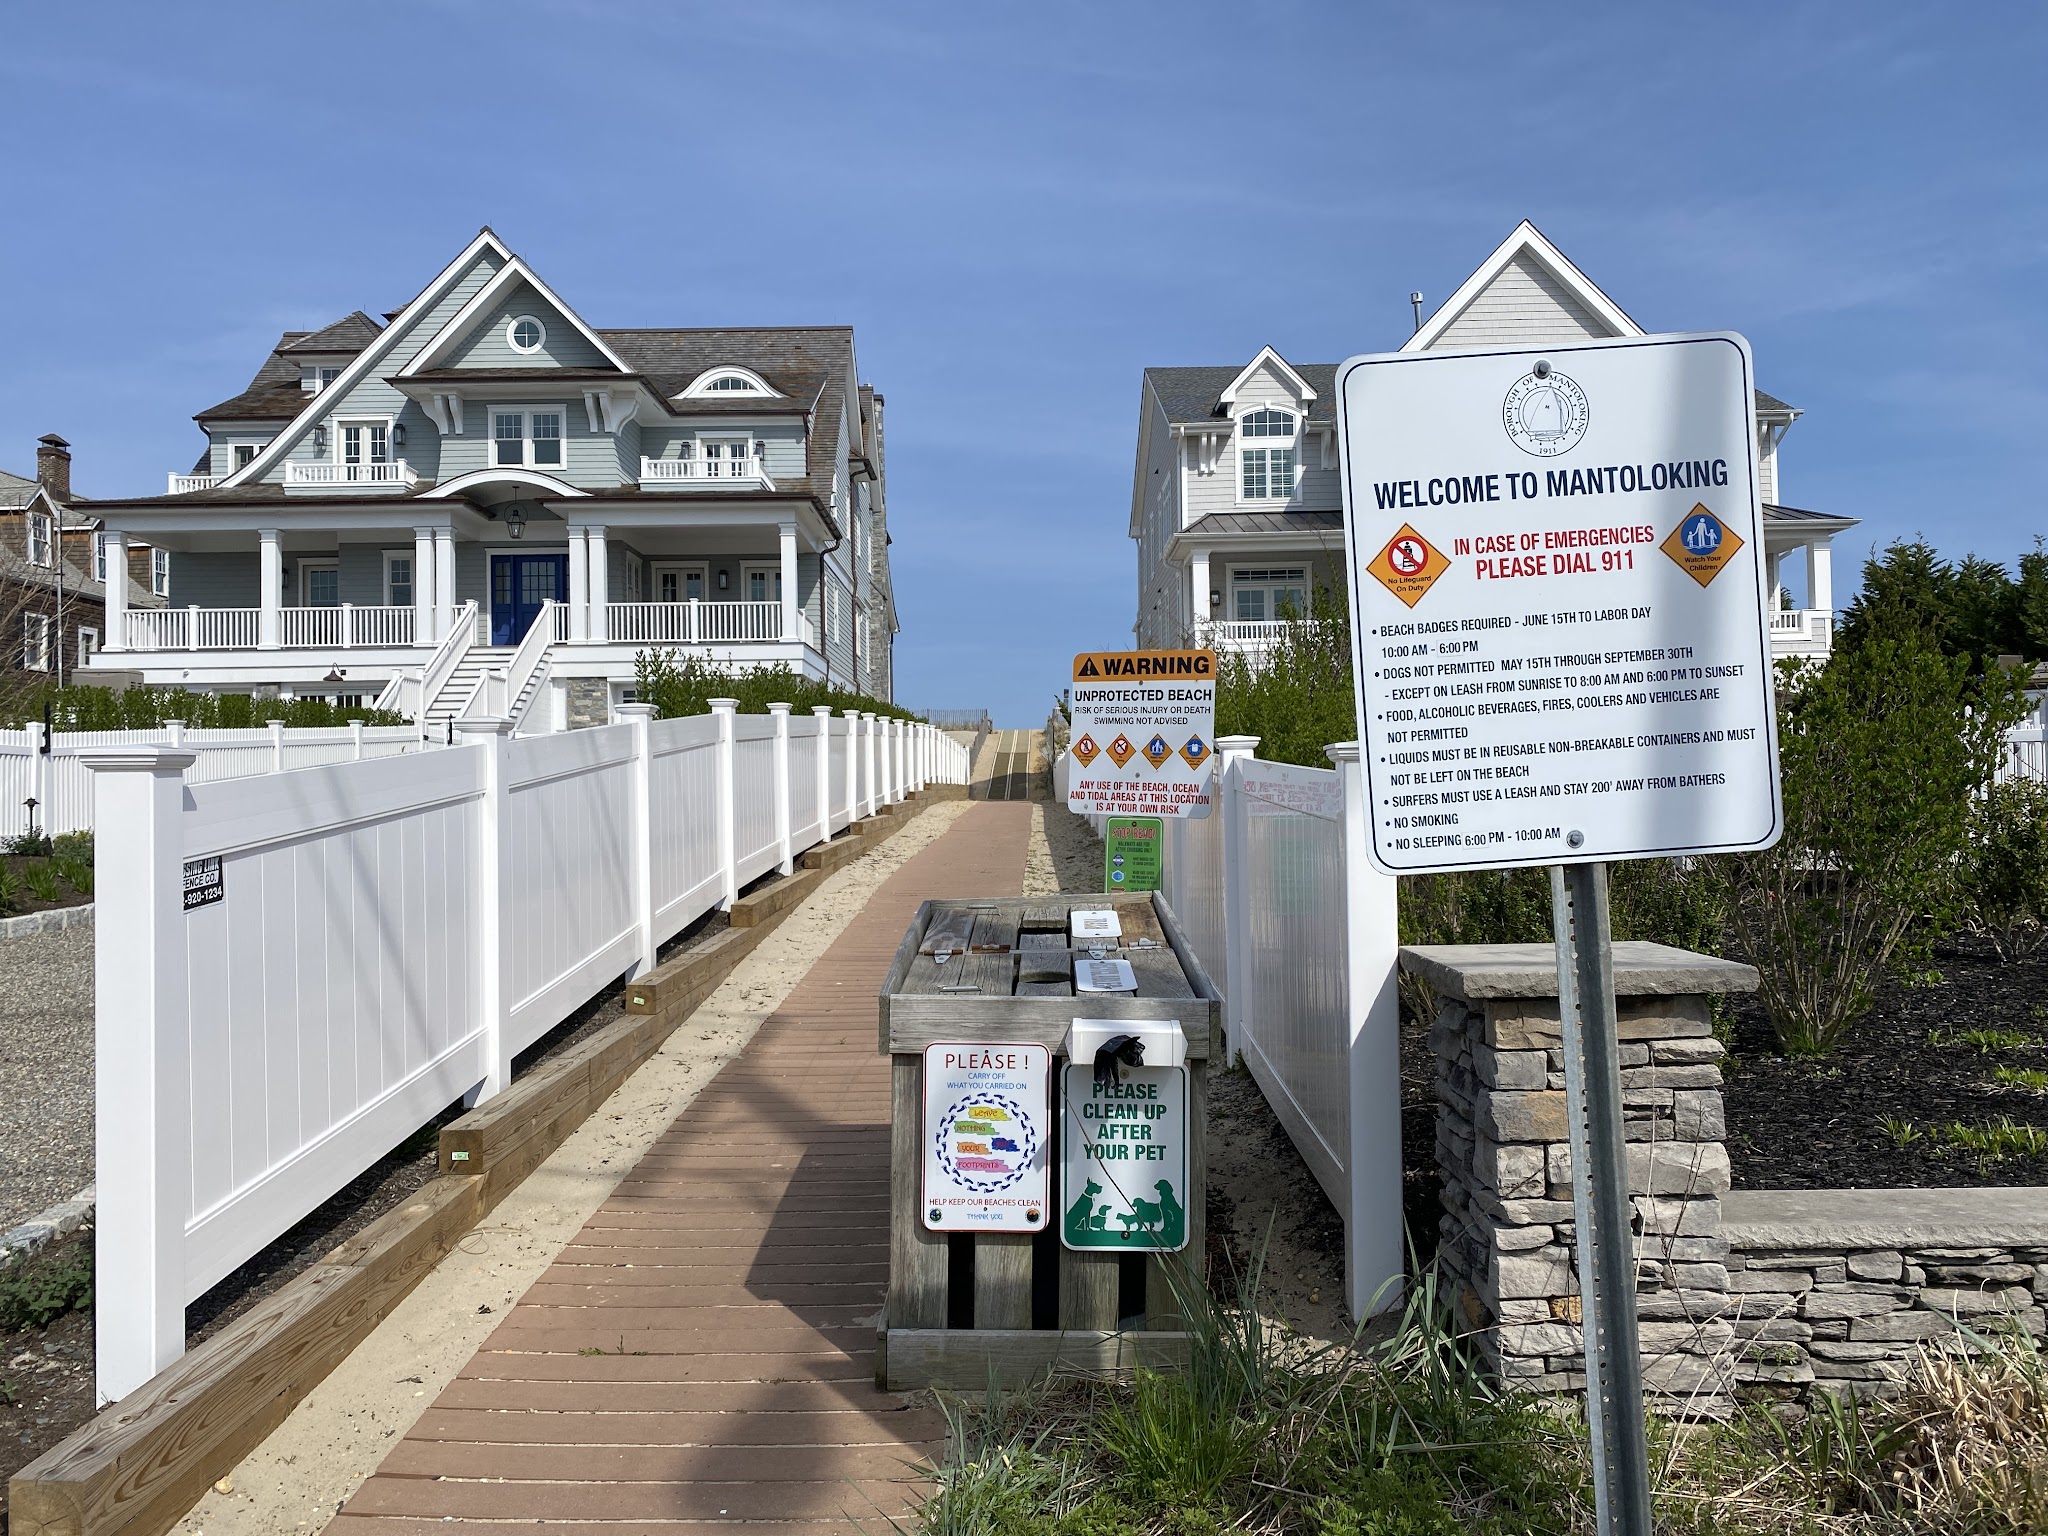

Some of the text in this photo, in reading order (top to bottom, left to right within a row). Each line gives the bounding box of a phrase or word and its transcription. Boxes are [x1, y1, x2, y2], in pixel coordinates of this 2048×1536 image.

[1506, 375, 1586, 436] BOROUGH OF MANTOLOKING
[1374, 459, 1728, 509] WELCOME TO MANTOLOKING
[1455, 526, 1654, 555] IN CASE OF EMERGENCIES
[1476, 550, 1632, 580] PLEASE DIAL 911
[1381, 607, 1651, 636] BEACH BADGES REQUIRED JUNE 15TH TO LABOR DAY
[1382, 640, 1478, 658] 10:00 AM 6:00 PM
[1103, 656, 1209, 675] WARNING
[1384, 647, 1692, 679] DOGS NOT PERMITTED MAY 15TH THROUGH SEPTEMBER 30TH
[1392, 665, 1744, 700] EXCEPT ON LEASH FROM SUNRISE TO 8:00 AM AND 6:00 PM TO SUNSET
[1075, 689, 1211, 701] UNPROTECTED BEACH
[1386, 688, 1720, 722] FOOD, ALCOHOLIC BEVERAGES, FIRES, COOLERS AND VEHICLES ARE
[1388, 727, 1468, 743] NOT PERMITTED
[1390, 728, 1755, 764] LIQUIDS MUST BE IN REUSABLE NON-BREAKABLE CONTAINERS AND MUST
[1391, 766, 1529, 786] NOT BE LEFT ON THE BEACH
[1080, 781, 1199, 794] ANY USE OF THE BEACH, OCEAN
[1392, 773, 1725, 807] SURFERS MUST USE A LEASH AND STAY 200' AWAY FROM BATHERS
[1070, 791, 1209, 804] AND TIDAL AREAS AT THIS LOCATION
[1097, 802, 1179, 814] IS AT YOUR OWN RISK
[1394, 813, 1458, 828] NO SMOKING
[1396, 828, 1560, 850] NO SLEEPING 6:00 PM 10:00 AM
[205, 873, 216, 884] CO.
[946, 1054, 1028, 1069] PLEASE !
[1093, 1083, 1157, 1099] PLEASE
[1083, 1103, 1166, 1119] CLEAN UP
[1098, 1124, 1151, 1140] AFTER
[1083, 1144, 1166, 1160] YOUR PET
